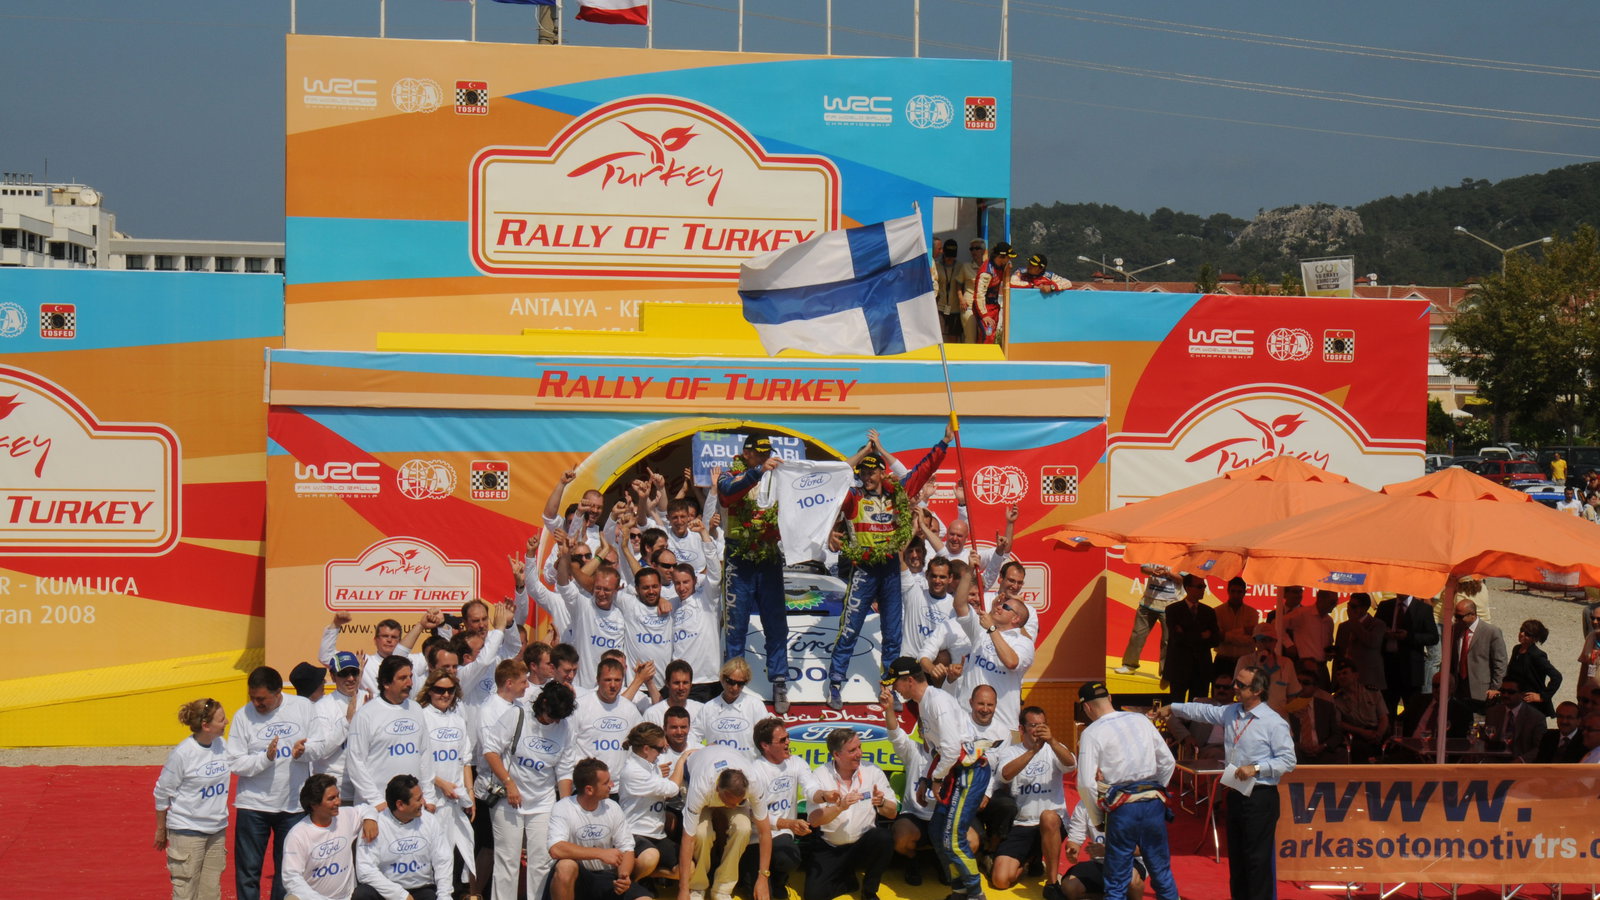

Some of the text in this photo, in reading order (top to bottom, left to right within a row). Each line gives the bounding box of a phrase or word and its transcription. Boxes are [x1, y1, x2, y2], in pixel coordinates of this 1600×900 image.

[304, 77, 377, 95] WRC
[457, 105, 487, 114] TOSFED
[824, 95, 893, 112] WRC
[966, 120, 994, 128] TOSFED
[567, 152, 723, 207] Turkey
[496, 219, 612, 249] RALLY
[624, 225, 669, 249] OF
[509, 297, 598, 317] ANTALYA
[42, 329, 74, 338] TOSFED
[1189, 328, 1255, 345] WRC
[536, 370, 858, 402] RALLY OF TURKEY
[700, 443, 739, 458] ABU
[295, 461, 380, 480] WRC
[800, 473, 825, 489] Ford
[473, 490, 507, 499] TOSFED
[7, 496, 155, 524] TURKEY
[365, 559, 431, 582] Turkey
[35, 576, 139, 595] KUMLUCA
[335, 588, 470, 601] RALLY OF TURKEY
[40, 605, 96, 624] 2008
[265, 724, 294, 738] Ford
[393, 719, 416, 731] Ford
[600, 718, 623, 730] Ford
[717, 719, 742, 730] Ford
[436, 729, 459, 739] Ford
[528, 737, 553, 751] Ford
[205, 762, 226, 776] Ford
[773, 778, 791, 792] Ford
[1288, 779, 1532, 824] www.
[318, 842, 341, 858] Ford
